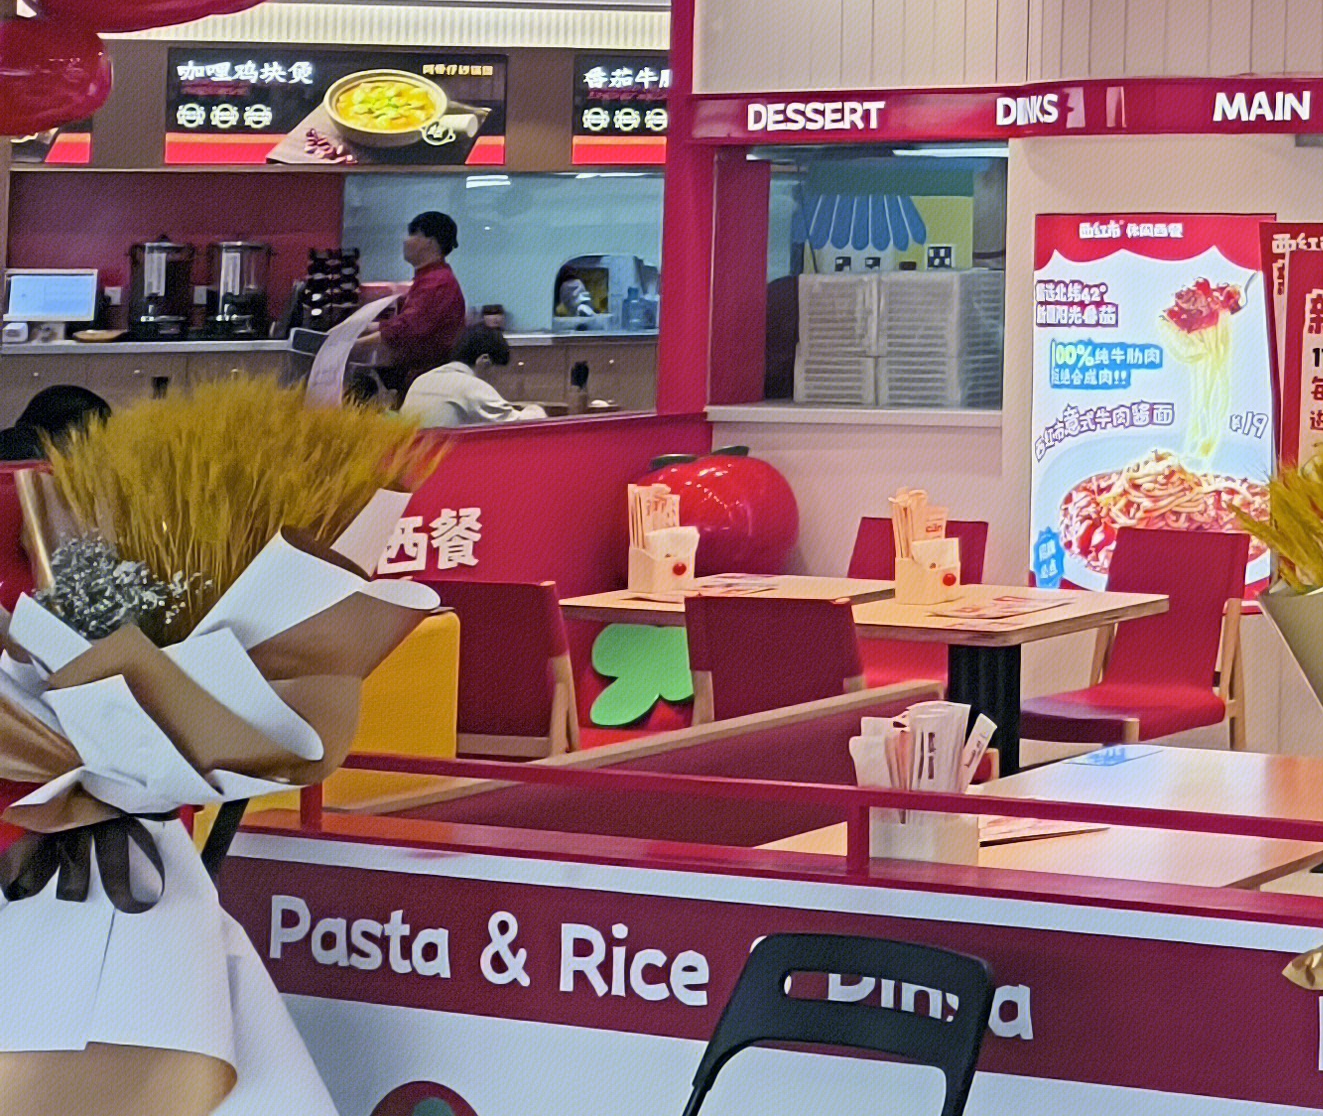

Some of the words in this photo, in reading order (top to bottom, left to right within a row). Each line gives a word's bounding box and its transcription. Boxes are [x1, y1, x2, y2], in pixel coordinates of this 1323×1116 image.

[748, 101, 885, 131] DESSERT
[1213, 90, 1311, 122] MAIN
[377, 507, 483, 575] 西餐
[270, 895, 452, 980] Pasta
[480, 911, 531, 987] &
[559, 922, 710, 1007] Rice
